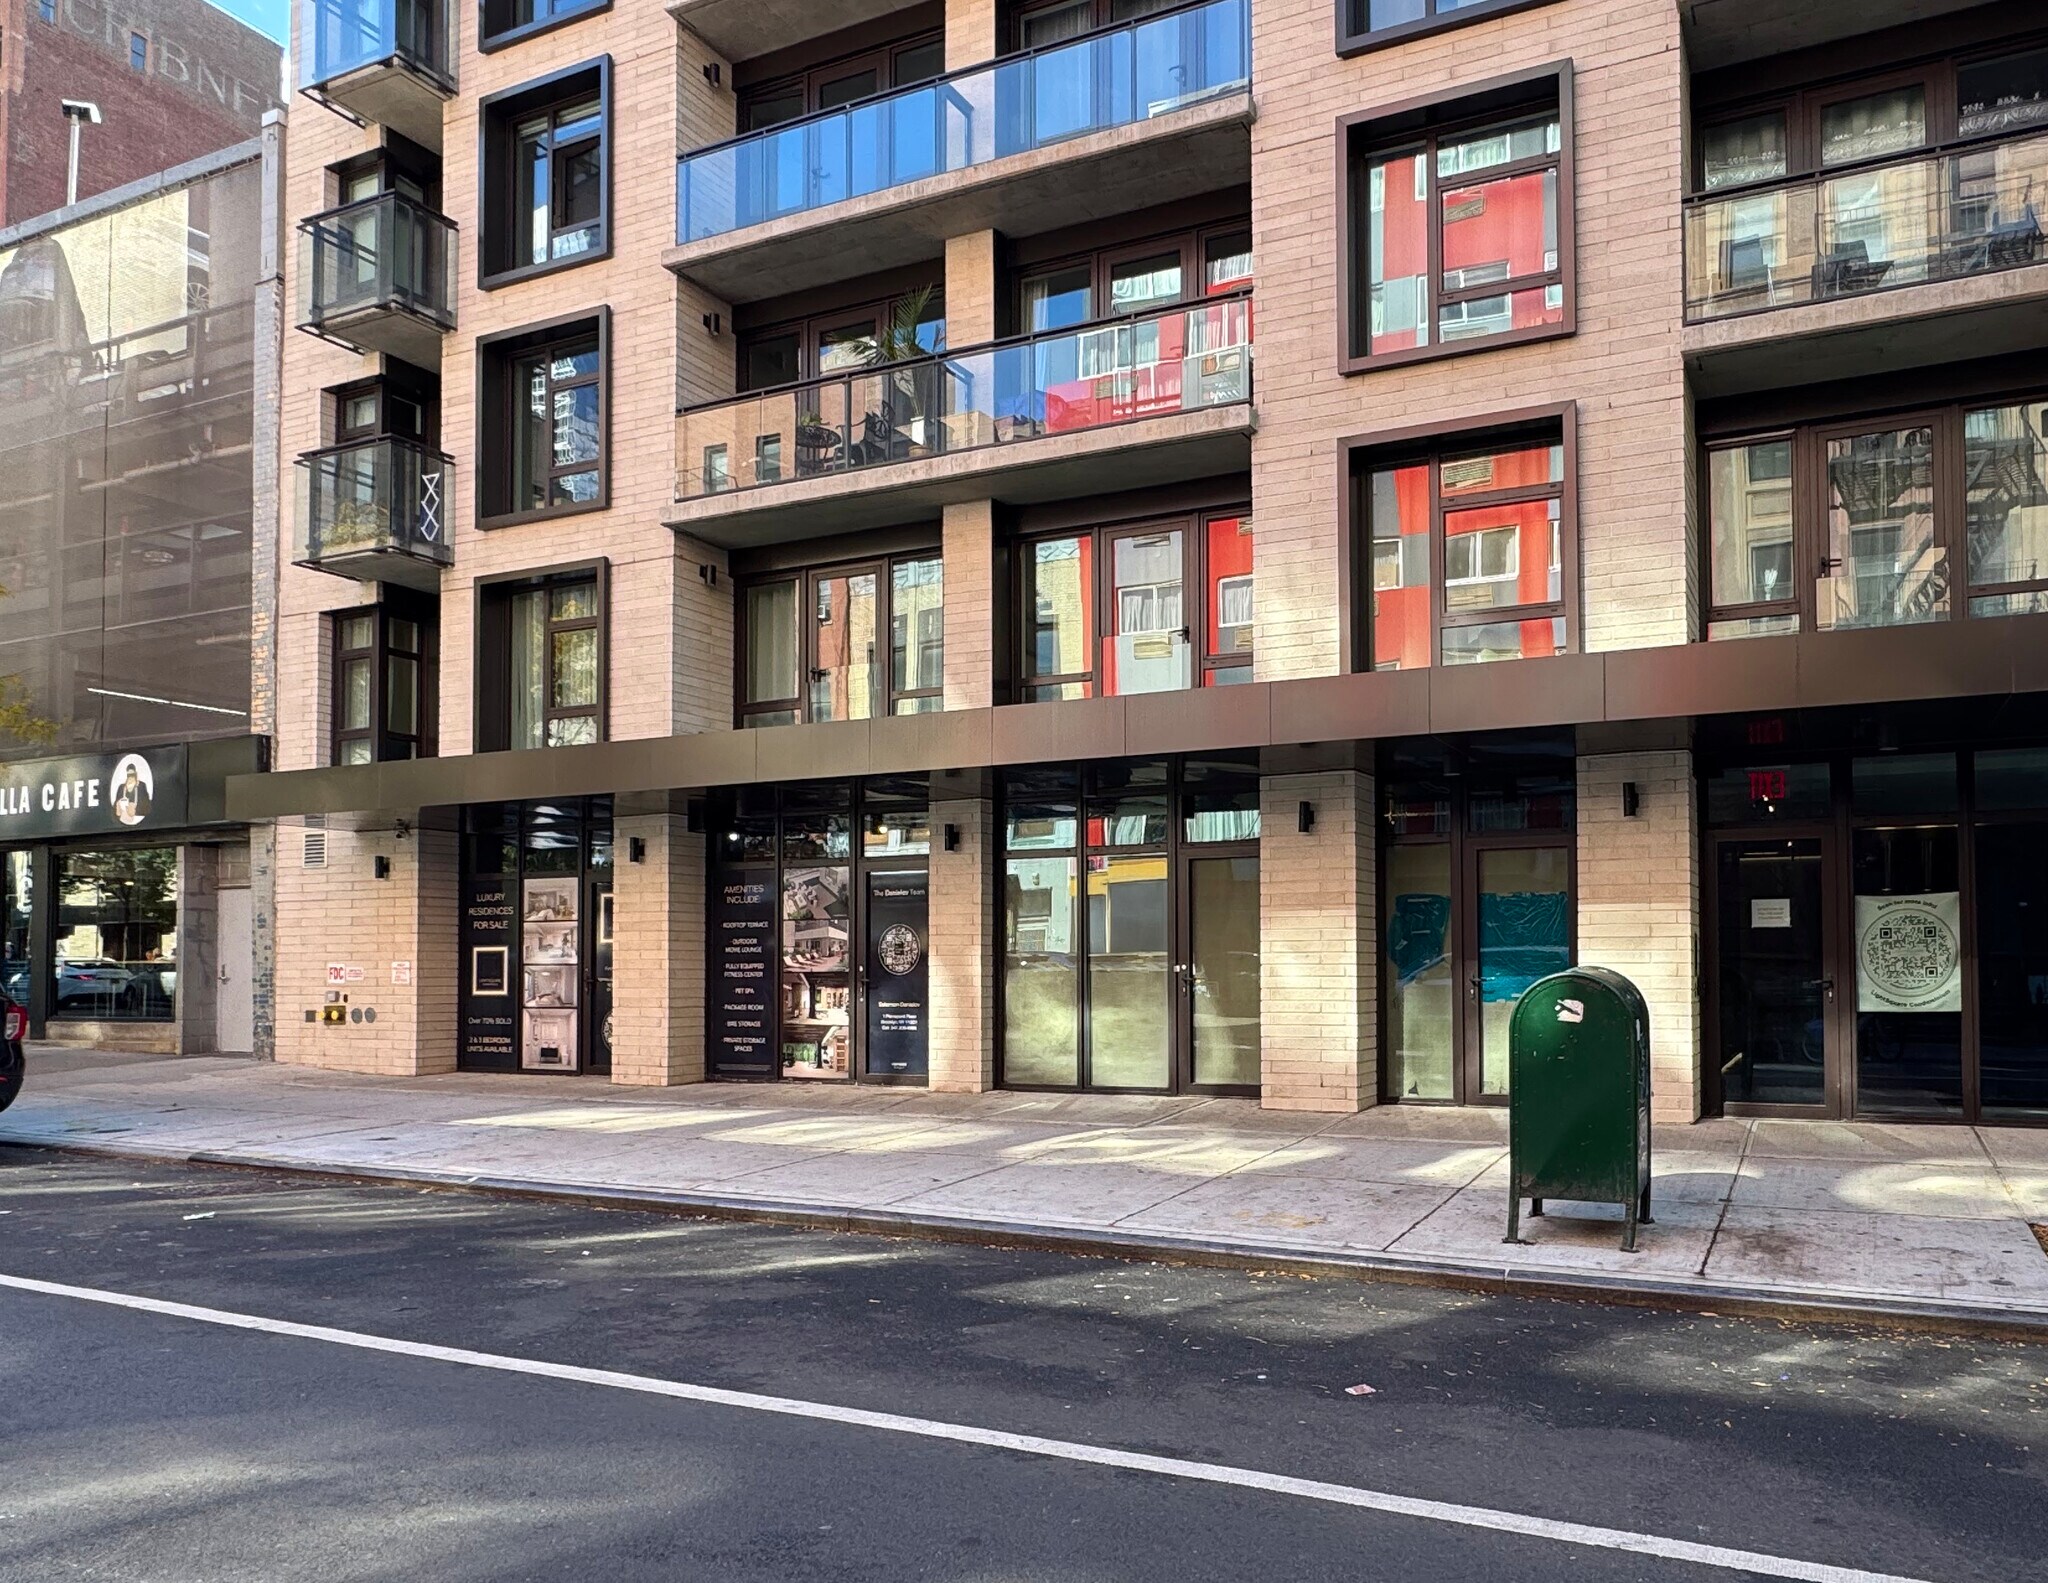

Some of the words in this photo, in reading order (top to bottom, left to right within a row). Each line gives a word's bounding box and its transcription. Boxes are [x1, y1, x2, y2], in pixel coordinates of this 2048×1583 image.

[42, 779, 99, 812] CAFE
[724, 884, 764, 893] AMENITIES
[476, 892, 505, 902] LUXURY
[726, 895, 760, 904] INCLUDE
[468, 906, 514, 916] RESIDENCES
[473, 920, 489, 929] FOR
[489, 920, 509, 929] SALE
[329, 966, 344, 980] FDC
